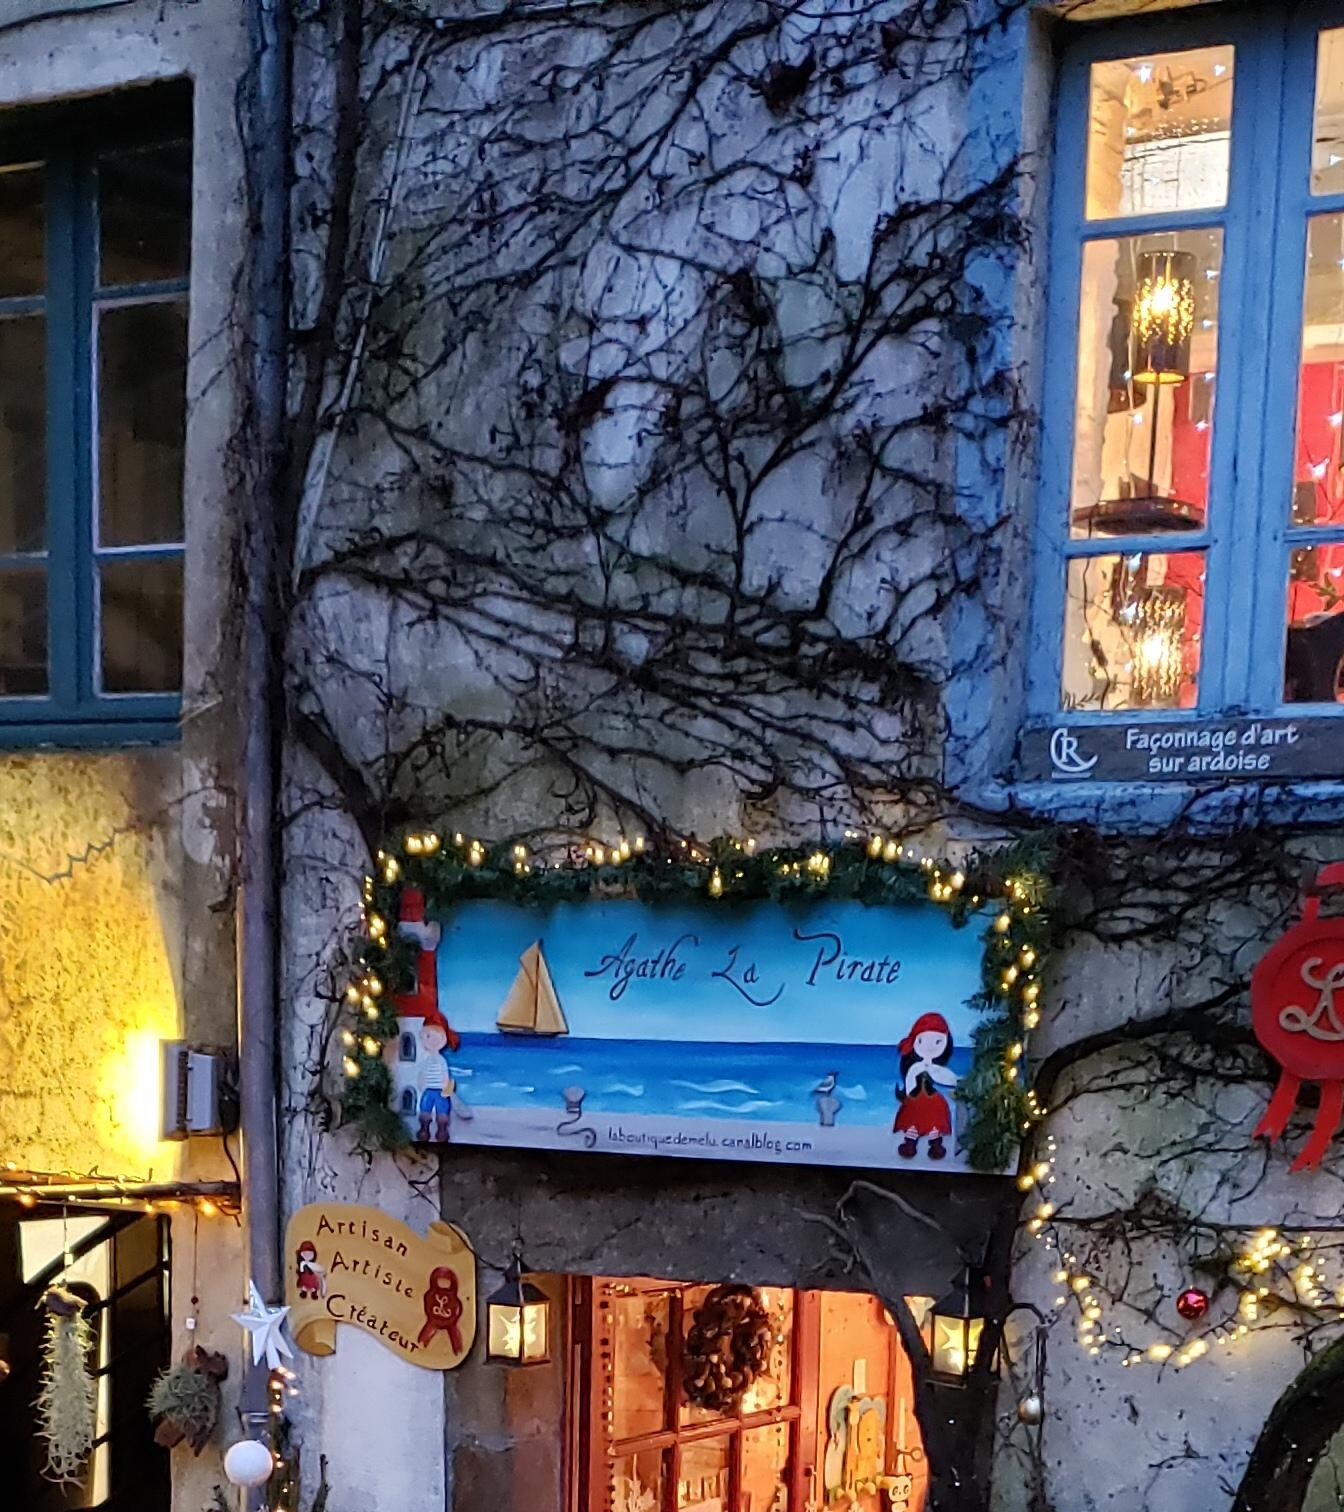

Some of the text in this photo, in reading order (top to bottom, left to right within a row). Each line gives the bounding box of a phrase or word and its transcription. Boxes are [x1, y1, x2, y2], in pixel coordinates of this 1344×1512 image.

[1125, 723, 1299, 754] Façonnage d'art
[1148, 749, 1270, 774] sur ardoise
[583, 927, 903, 1007] Agathe La Pirate
[316, 1213, 409, 1258] Artisan
[330, 1250, 414, 1300] Artiste
[326, 1293, 420, 1354] Créateur
